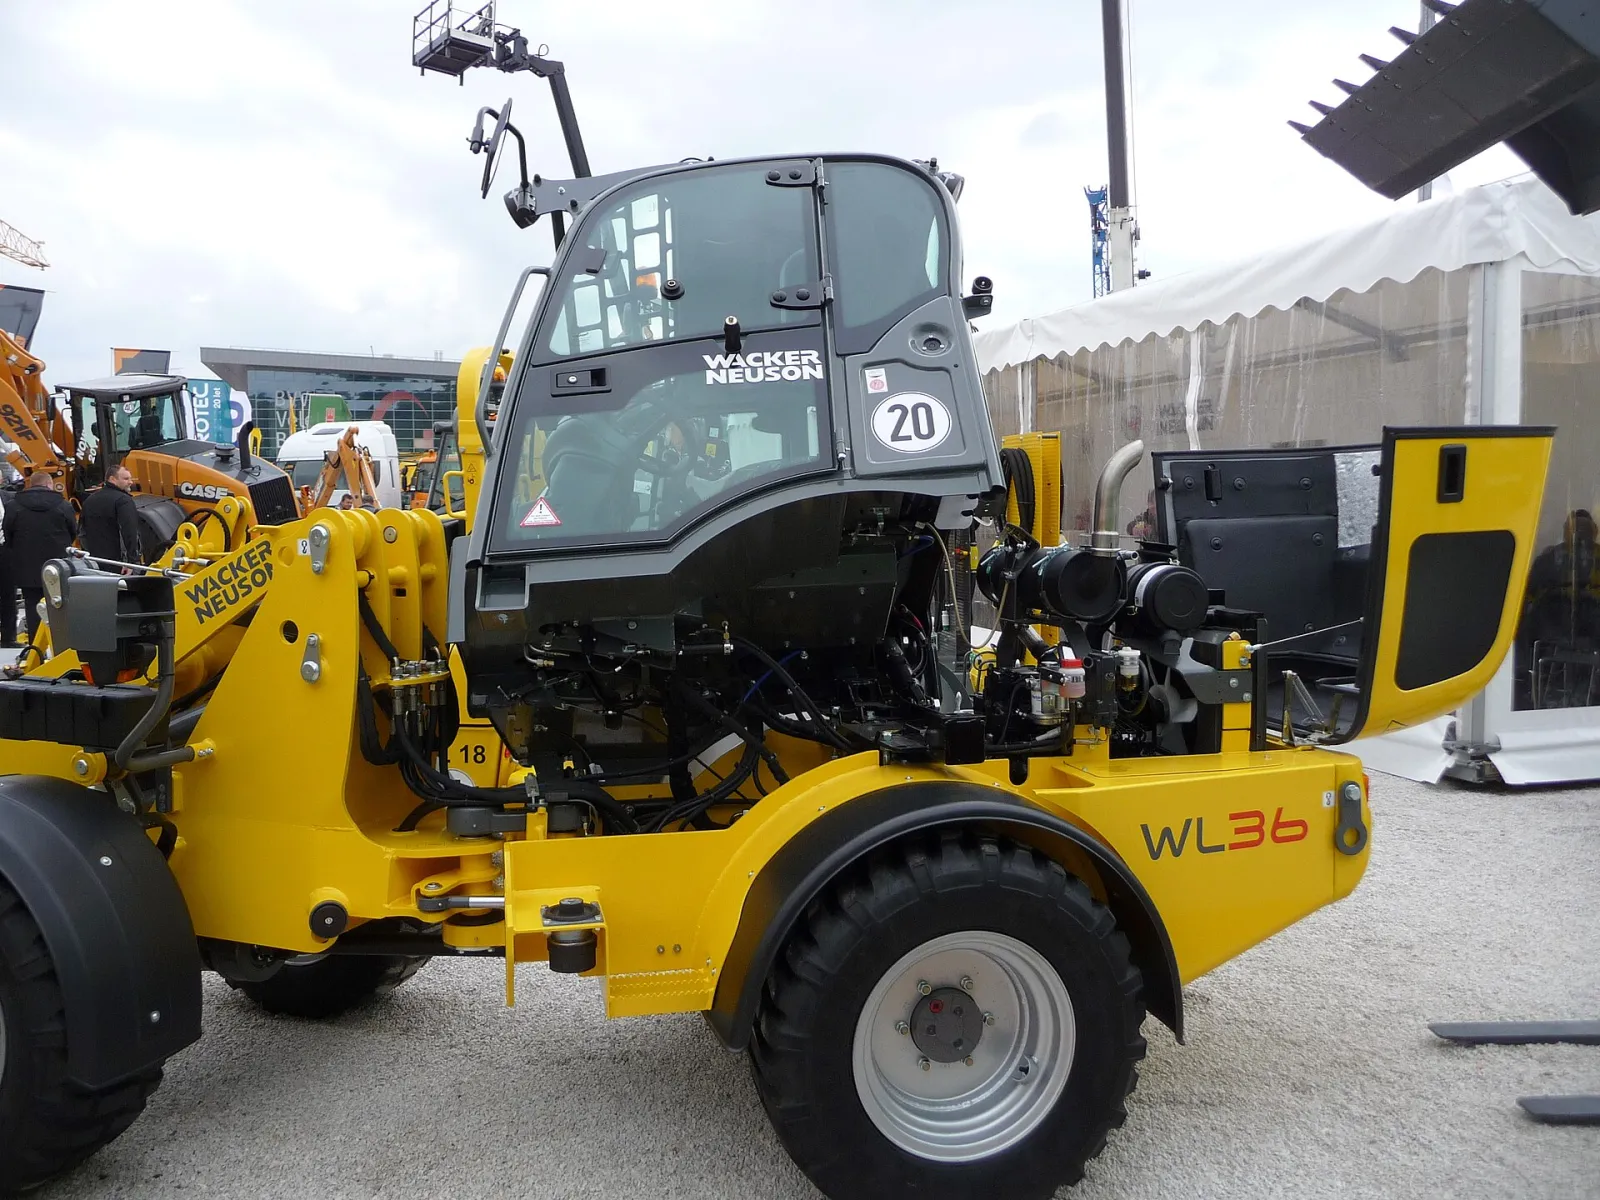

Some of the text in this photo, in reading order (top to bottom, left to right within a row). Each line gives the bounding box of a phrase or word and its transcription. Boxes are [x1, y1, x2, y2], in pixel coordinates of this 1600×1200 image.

[702, 350, 821, 369] WACKER
[706, 365, 824, 385] NEUSON
[0, 403, 39, 441] 921F
[887, 402, 936, 443] 20
[181, 482, 229, 500] CASE
[184, 540, 272, 605] WACKER
[459, 744, 486, 764] 18
[1139, 806, 1309, 861] WL36
